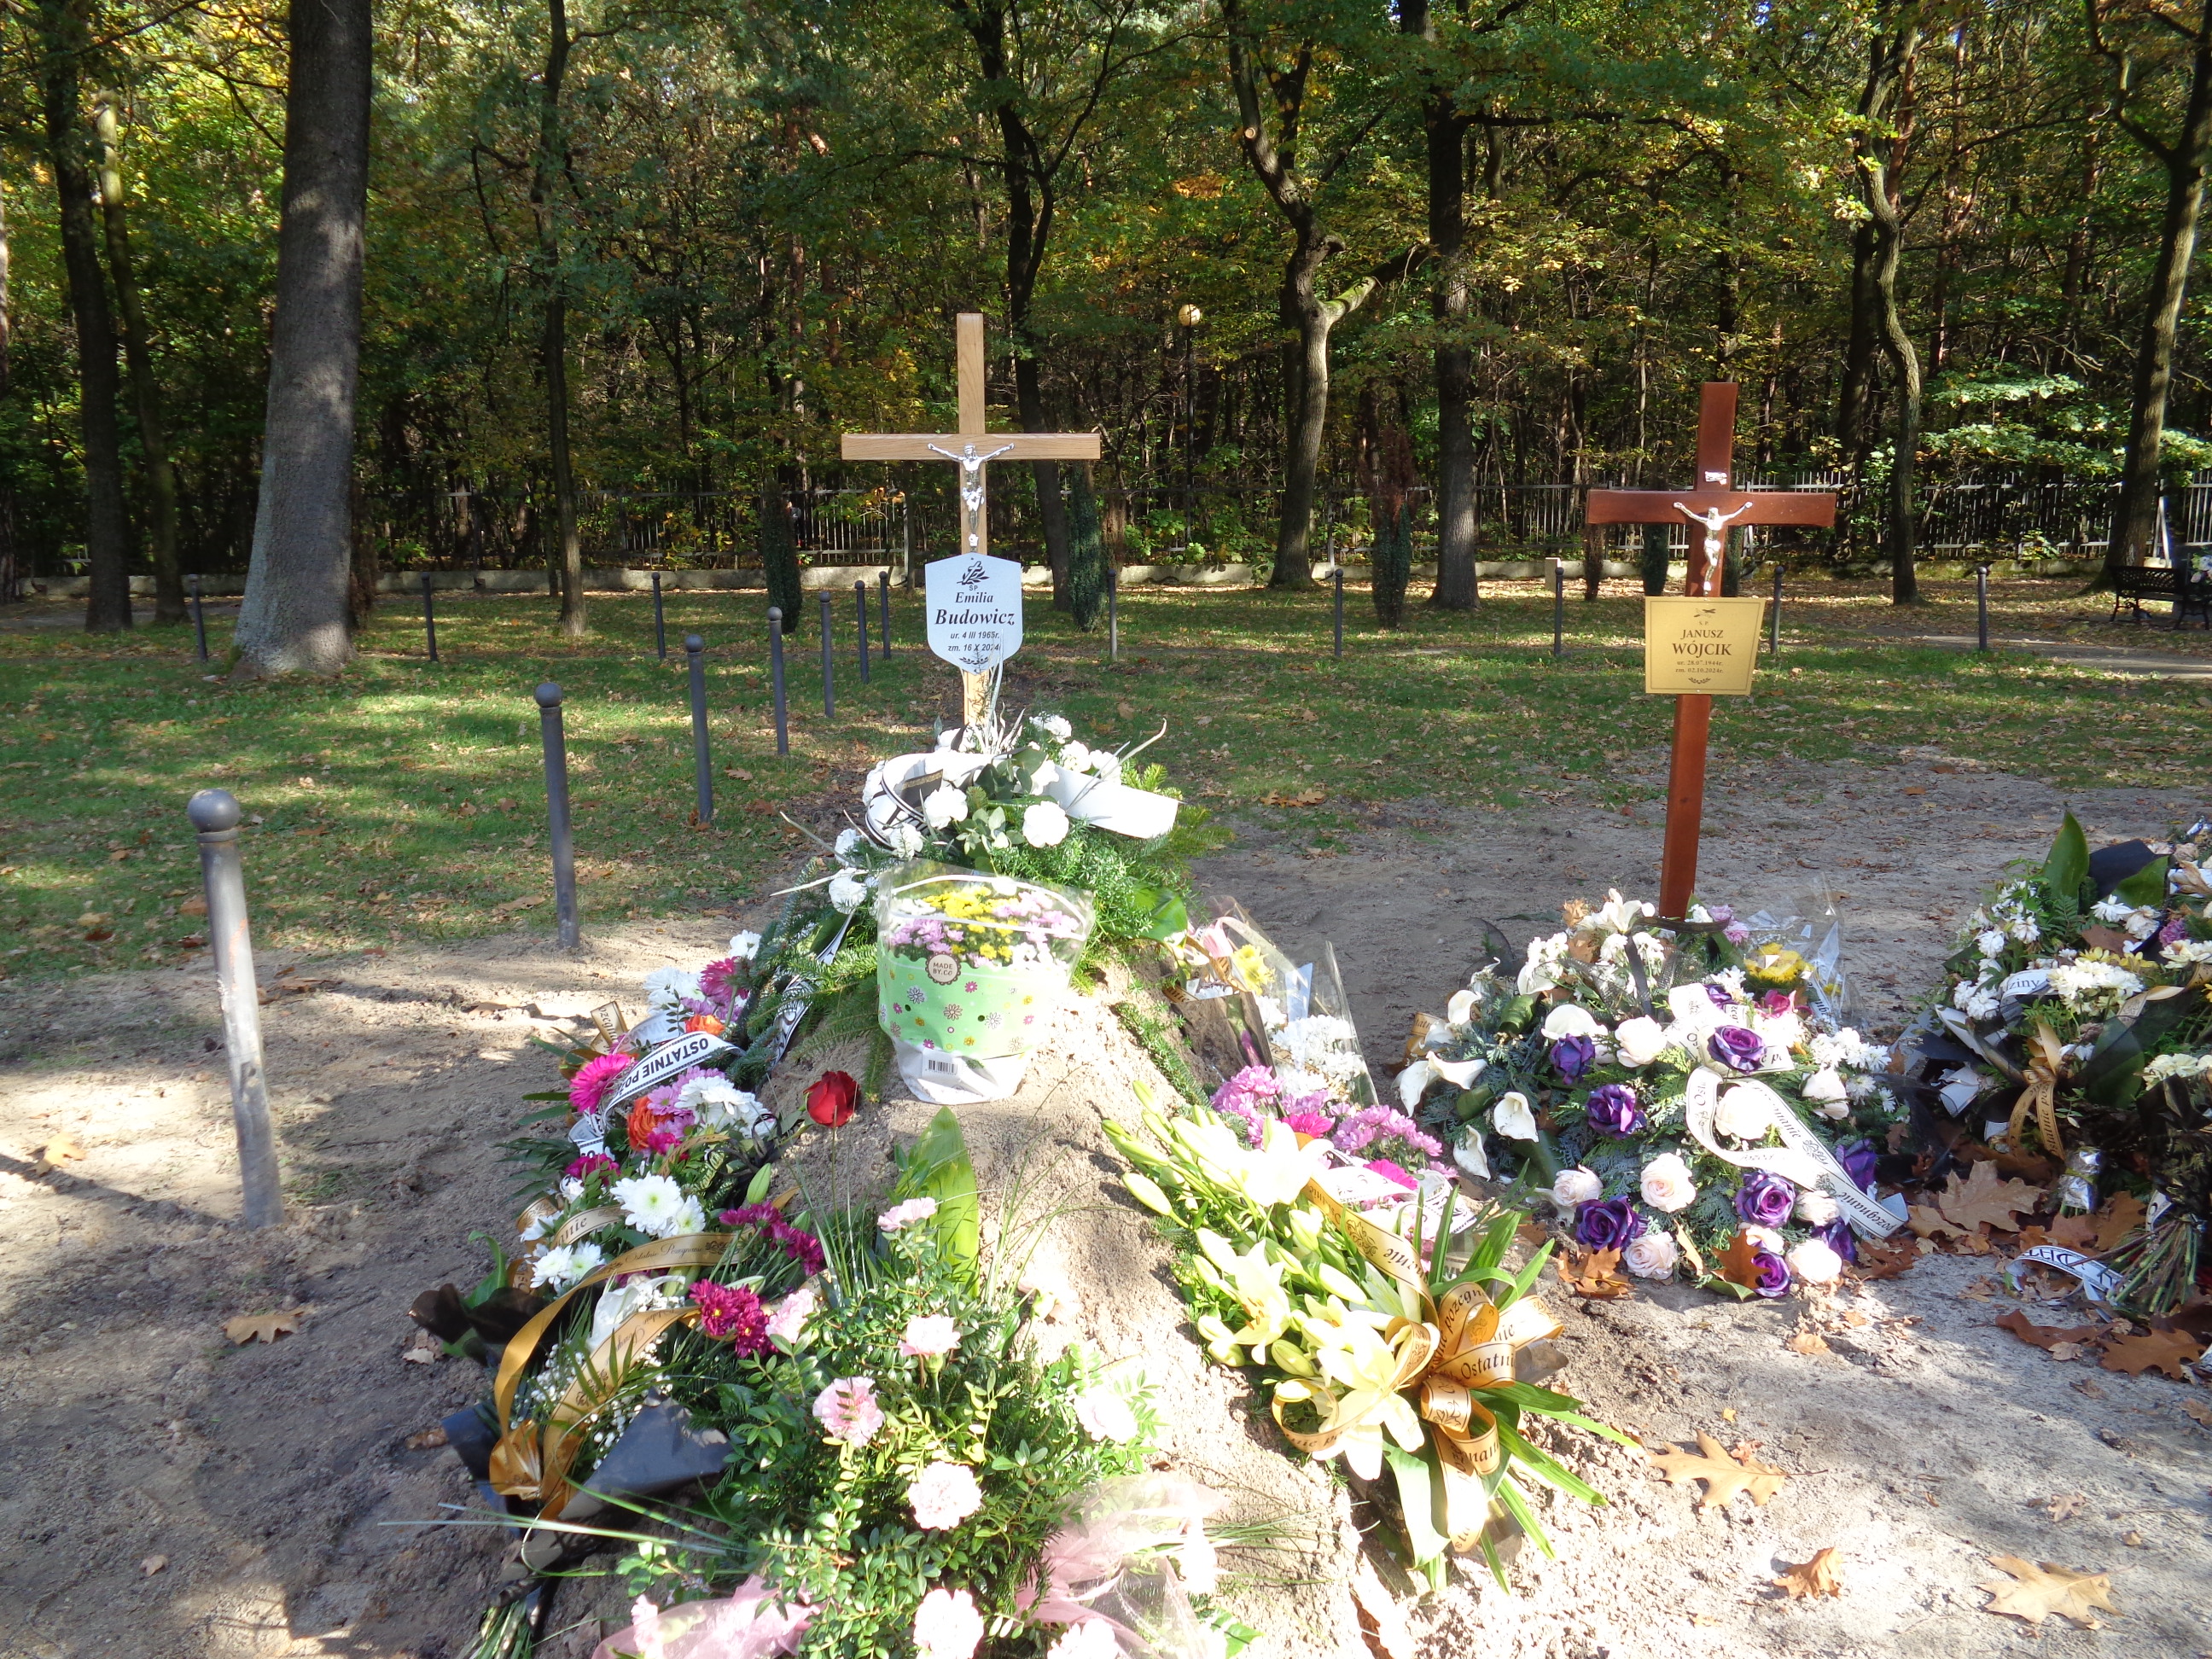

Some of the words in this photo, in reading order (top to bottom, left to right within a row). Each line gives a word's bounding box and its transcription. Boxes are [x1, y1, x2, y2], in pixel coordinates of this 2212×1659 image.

[955, 591, 993, 603] Emilia
[935, 608, 1016, 626] Budowicz
[962, 631, 968, 639] 4
[968, 631, 976, 639] III
[1679, 629, 1724, 640] JANUSZ
[963, 643, 973, 652] 16
[973, 643, 981, 652] X
[1672, 640, 1732, 659] WÓJCIK
[933, 962, 953, 970] MADE
[643, 1038, 709, 1079] OSTATNIE
